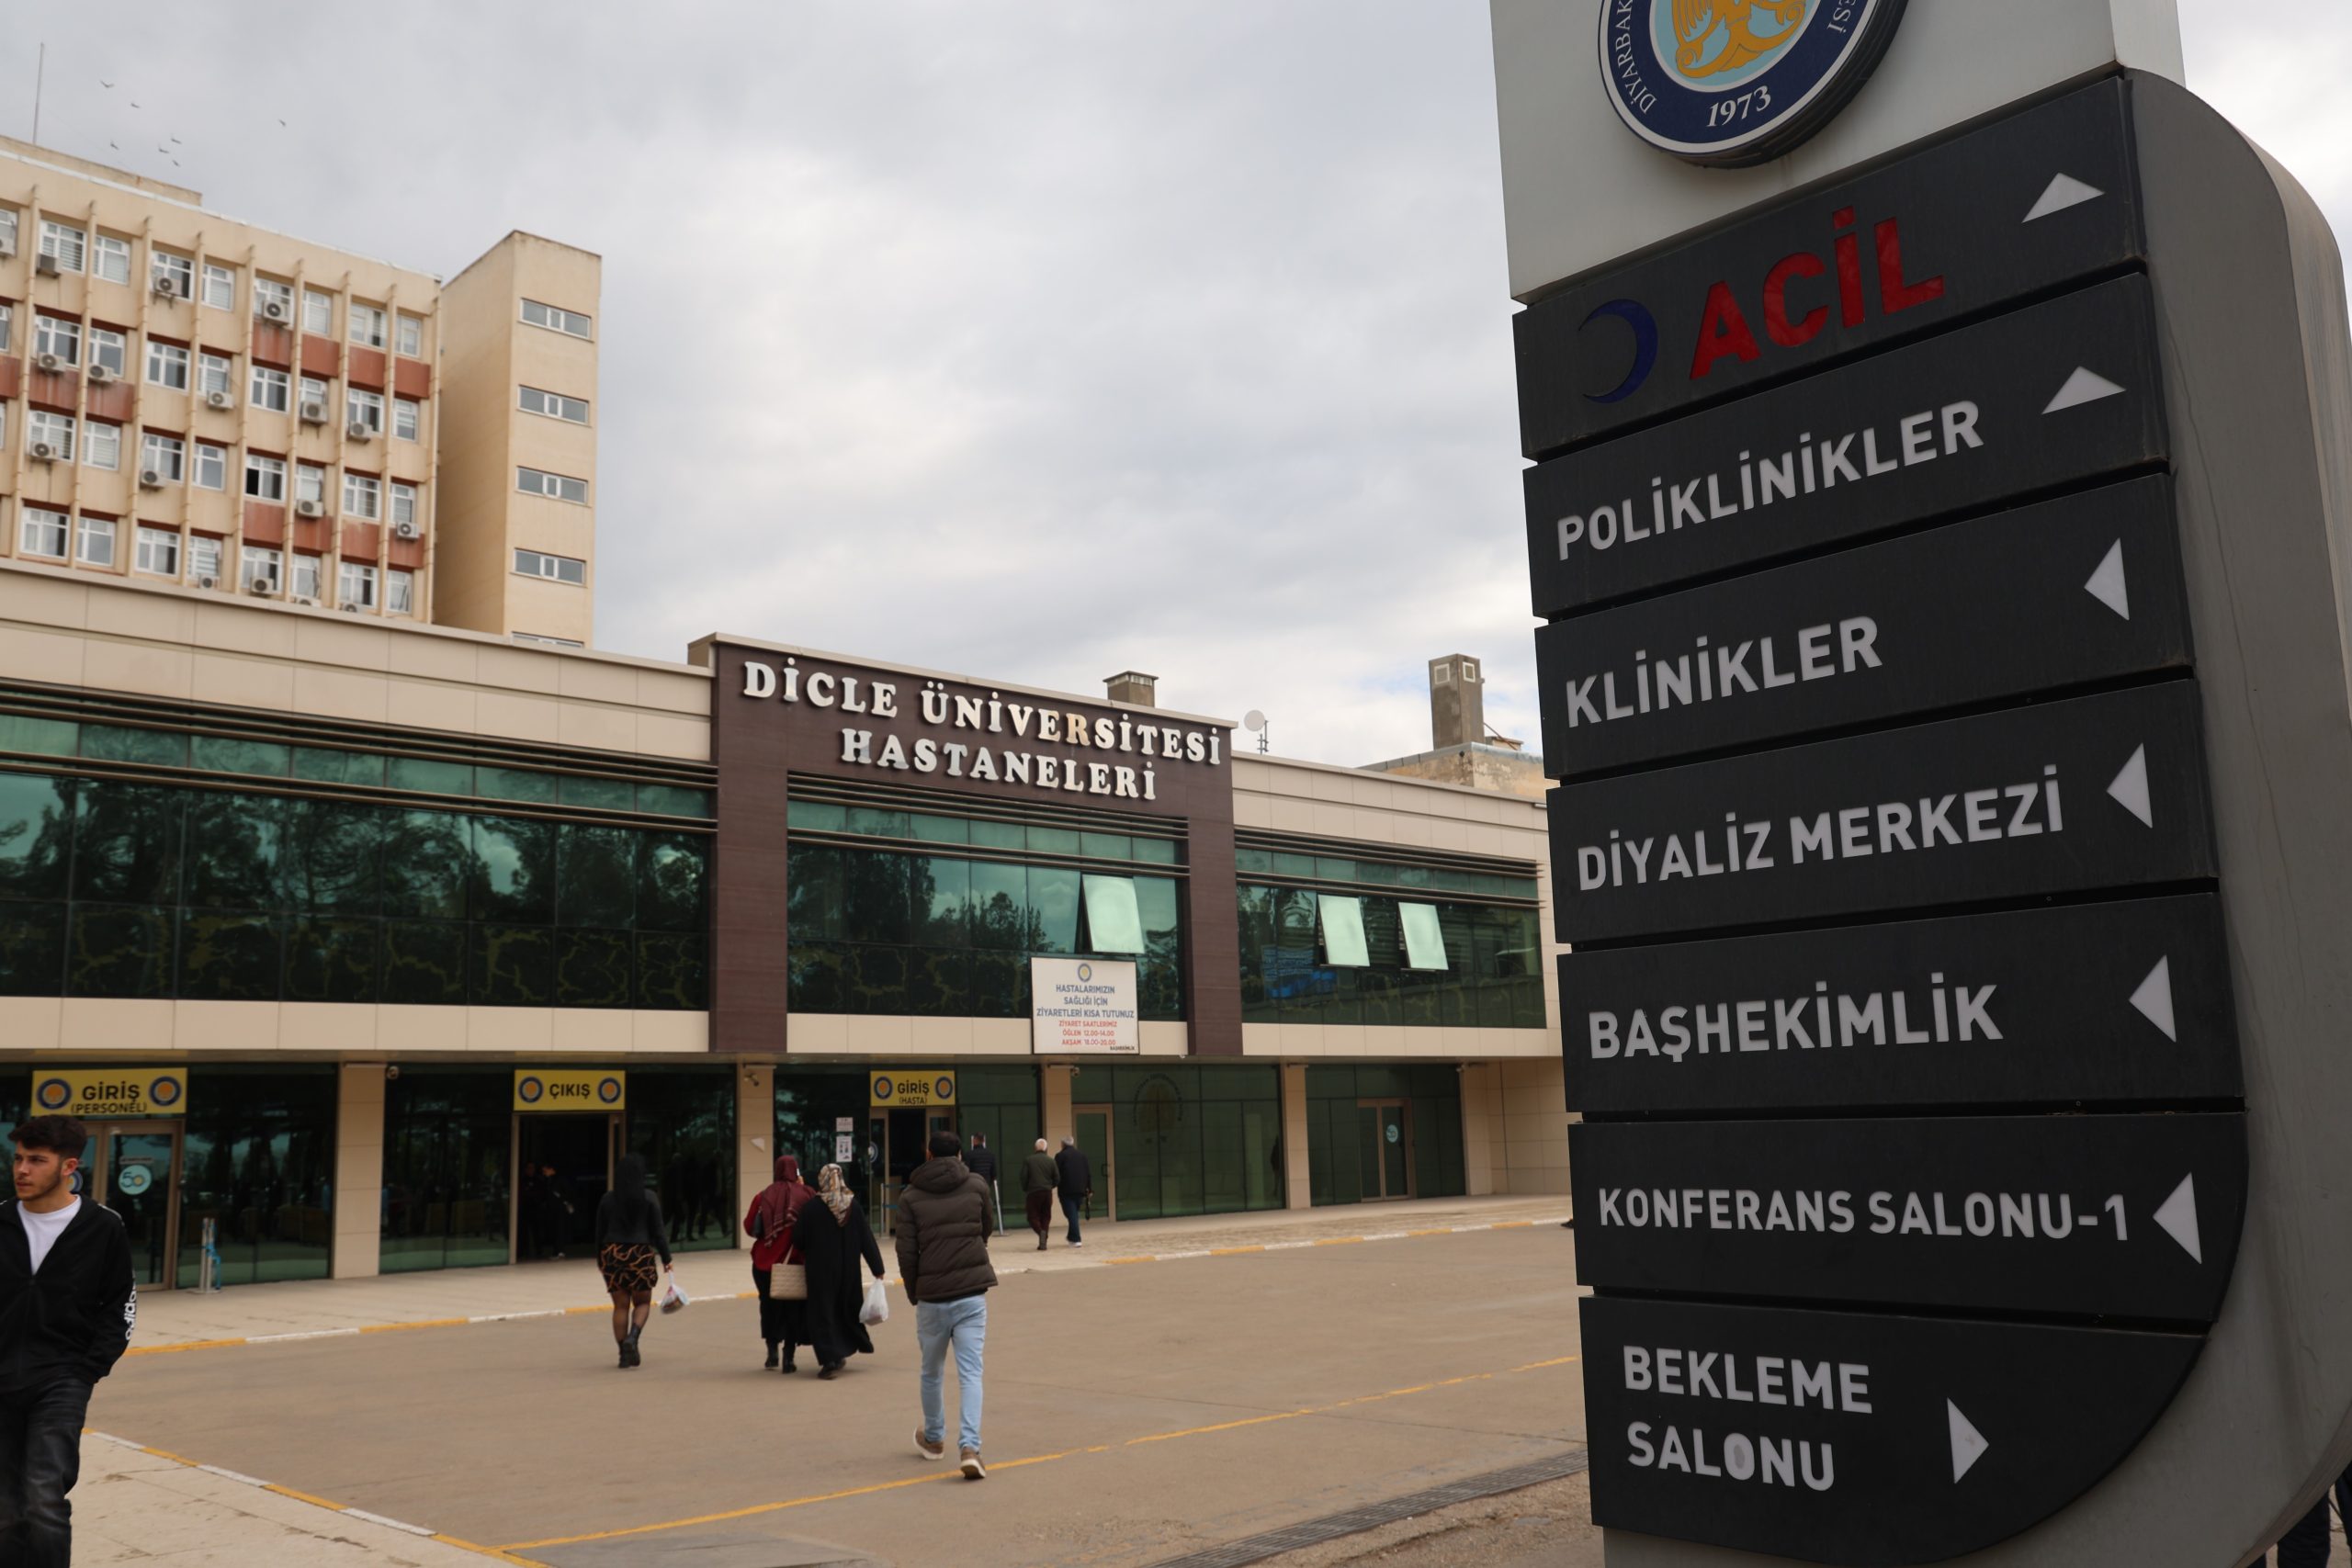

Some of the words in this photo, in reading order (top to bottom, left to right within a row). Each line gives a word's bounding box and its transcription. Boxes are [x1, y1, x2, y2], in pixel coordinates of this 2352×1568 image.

[1706, 85, 1771, 127] 1973
[1690, 206, 1945, 379] ACİL
[1557, 400, 1984, 560] POLİKLİNİKLER
[1566, 616, 1883, 728] KLİNİKLER
[743, 657, 898, 718] DİCLE
[921, 681, 1221, 765] ÜNİVERSİTESİ
[841, 727, 1157, 800] HASTANELERİ
[1577, 811, 1774, 890] DİYALİZ
[1791, 764, 2064, 864] MERKEZİ
[1036, 1008, 1082, 1017] ZİYARETLERİ
[1056, 985, 1115, 994] HASTALARIMIZIN
[1064, 996, 1092, 1005] SAĞLIĞI
[1093, 997, 1108, 1007] İÇİN
[1589, 972, 2004, 1062] BAŞHEKİMLİK
[71, 1102, 147, 1114] (PERSONEL)
[82, 1081, 141, 1101] GİRİŞ
[549, 1083, 591, 1100] ÇIKIŞ
[898, 1079, 930, 1096] GİRİŞ
[1599, 1188, 1855, 1233] KONFERANS
[1869, 1191, 2128, 1241] SALONU-1
[1623, 1345, 1872, 1414] BEKLEME
[1626, 1421, 1835, 1492] SALONU
